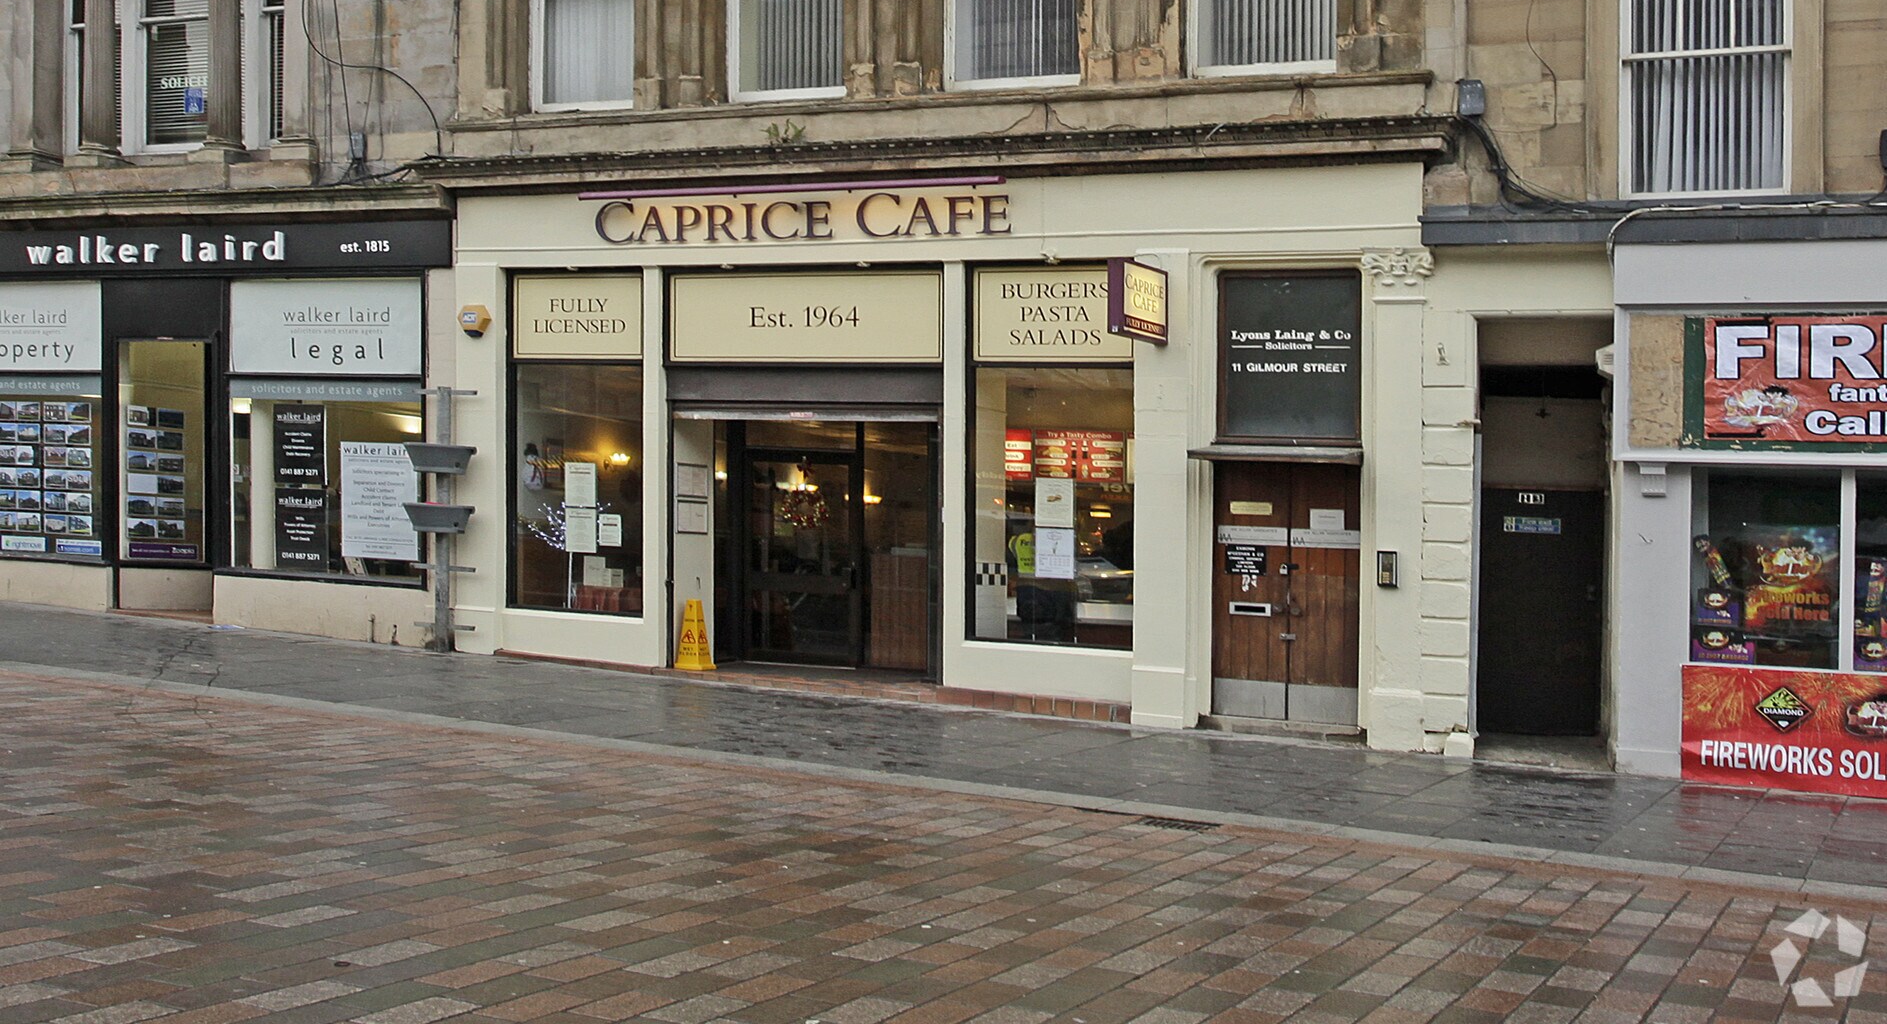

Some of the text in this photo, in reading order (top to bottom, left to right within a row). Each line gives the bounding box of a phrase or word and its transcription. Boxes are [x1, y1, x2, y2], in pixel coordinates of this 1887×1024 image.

[595, 192, 1012, 244] CAPRICE CAFE
[26, 230, 286, 265] walker laird
[340, 240, 390, 253] est. 1815
[1001, 282, 1109, 299] BURGERS
[1125, 274, 1164, 300] CAPRICE
[550, 298, 608, 313] FULLY
[1133, 293, 1158, 313] CAFE
[33, 309, 67, 324] laird
[283, 307, 391, 323] walker laird
[749, 305, 860, 328] Est. 1964
[1020, 306, 1090, 322] PASTA
[534, 319, 626, 334] LICENSED
[1010, 329, 1102, 346] SALADS
[1231, 329, 1352, 342] Lyons Laing & Co
[290, 337, 384, 365] legal
[1265, 341, 1313, 350] Solicitors
[1714, 324, 1887, 379] FIR
[1231, 362, 1347, 373] 11 GILMOUR STREET
[18, 380, 47, 390] estate
[50, 381, 81, 391] agents
[251, 383, 403, 397] solicitors and estate agents
[276, 412, 322, 422] walker laird
[1804, 409, 1887, 436] Cal
[1047, 431, 1059, 439] Try
[1066, 431, 1085, 440] Tasty
[1086, 432, 1112, 440] Combo
[343, 445, 407, 456] walker lair
[278, 496, 323, 507] walker laird
[1763, 707, 1804, 717] DIAMOND
[1700, 739, 1833, 777] FIREWORKS
